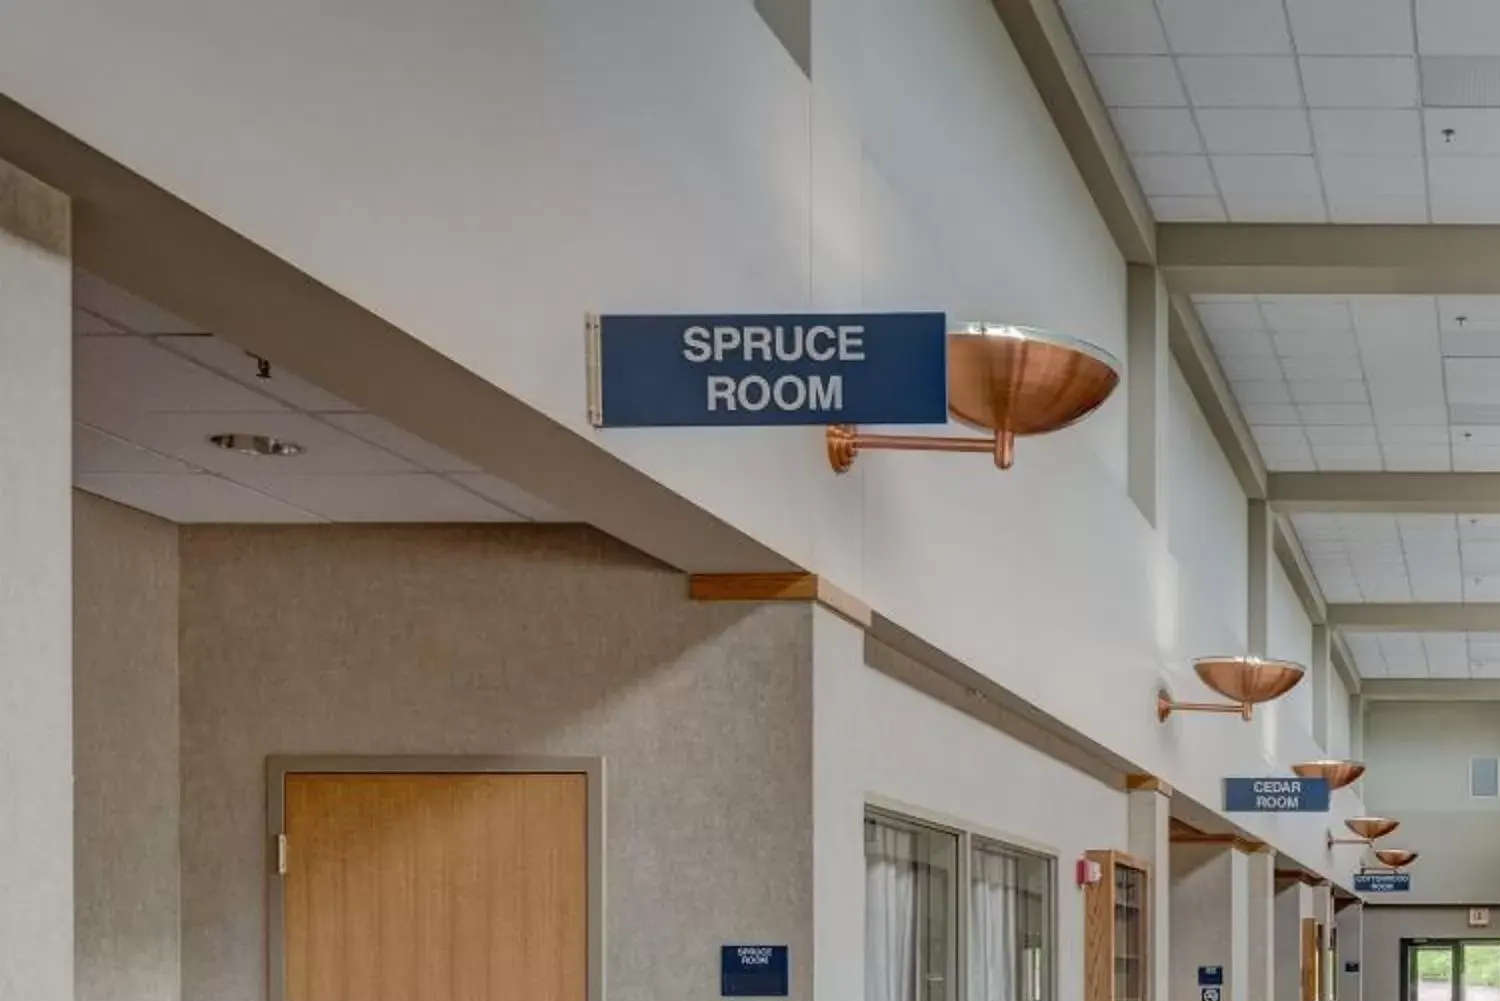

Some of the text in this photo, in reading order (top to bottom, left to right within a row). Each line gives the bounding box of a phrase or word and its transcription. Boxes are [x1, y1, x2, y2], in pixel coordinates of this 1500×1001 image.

[682, 325, 866, 362] SPRUCE
[706, 375, 843, 411] ROOM
[1253, 781, 1301, 793] CEDAR
[1256, 795, 1299, 809] ROOM
